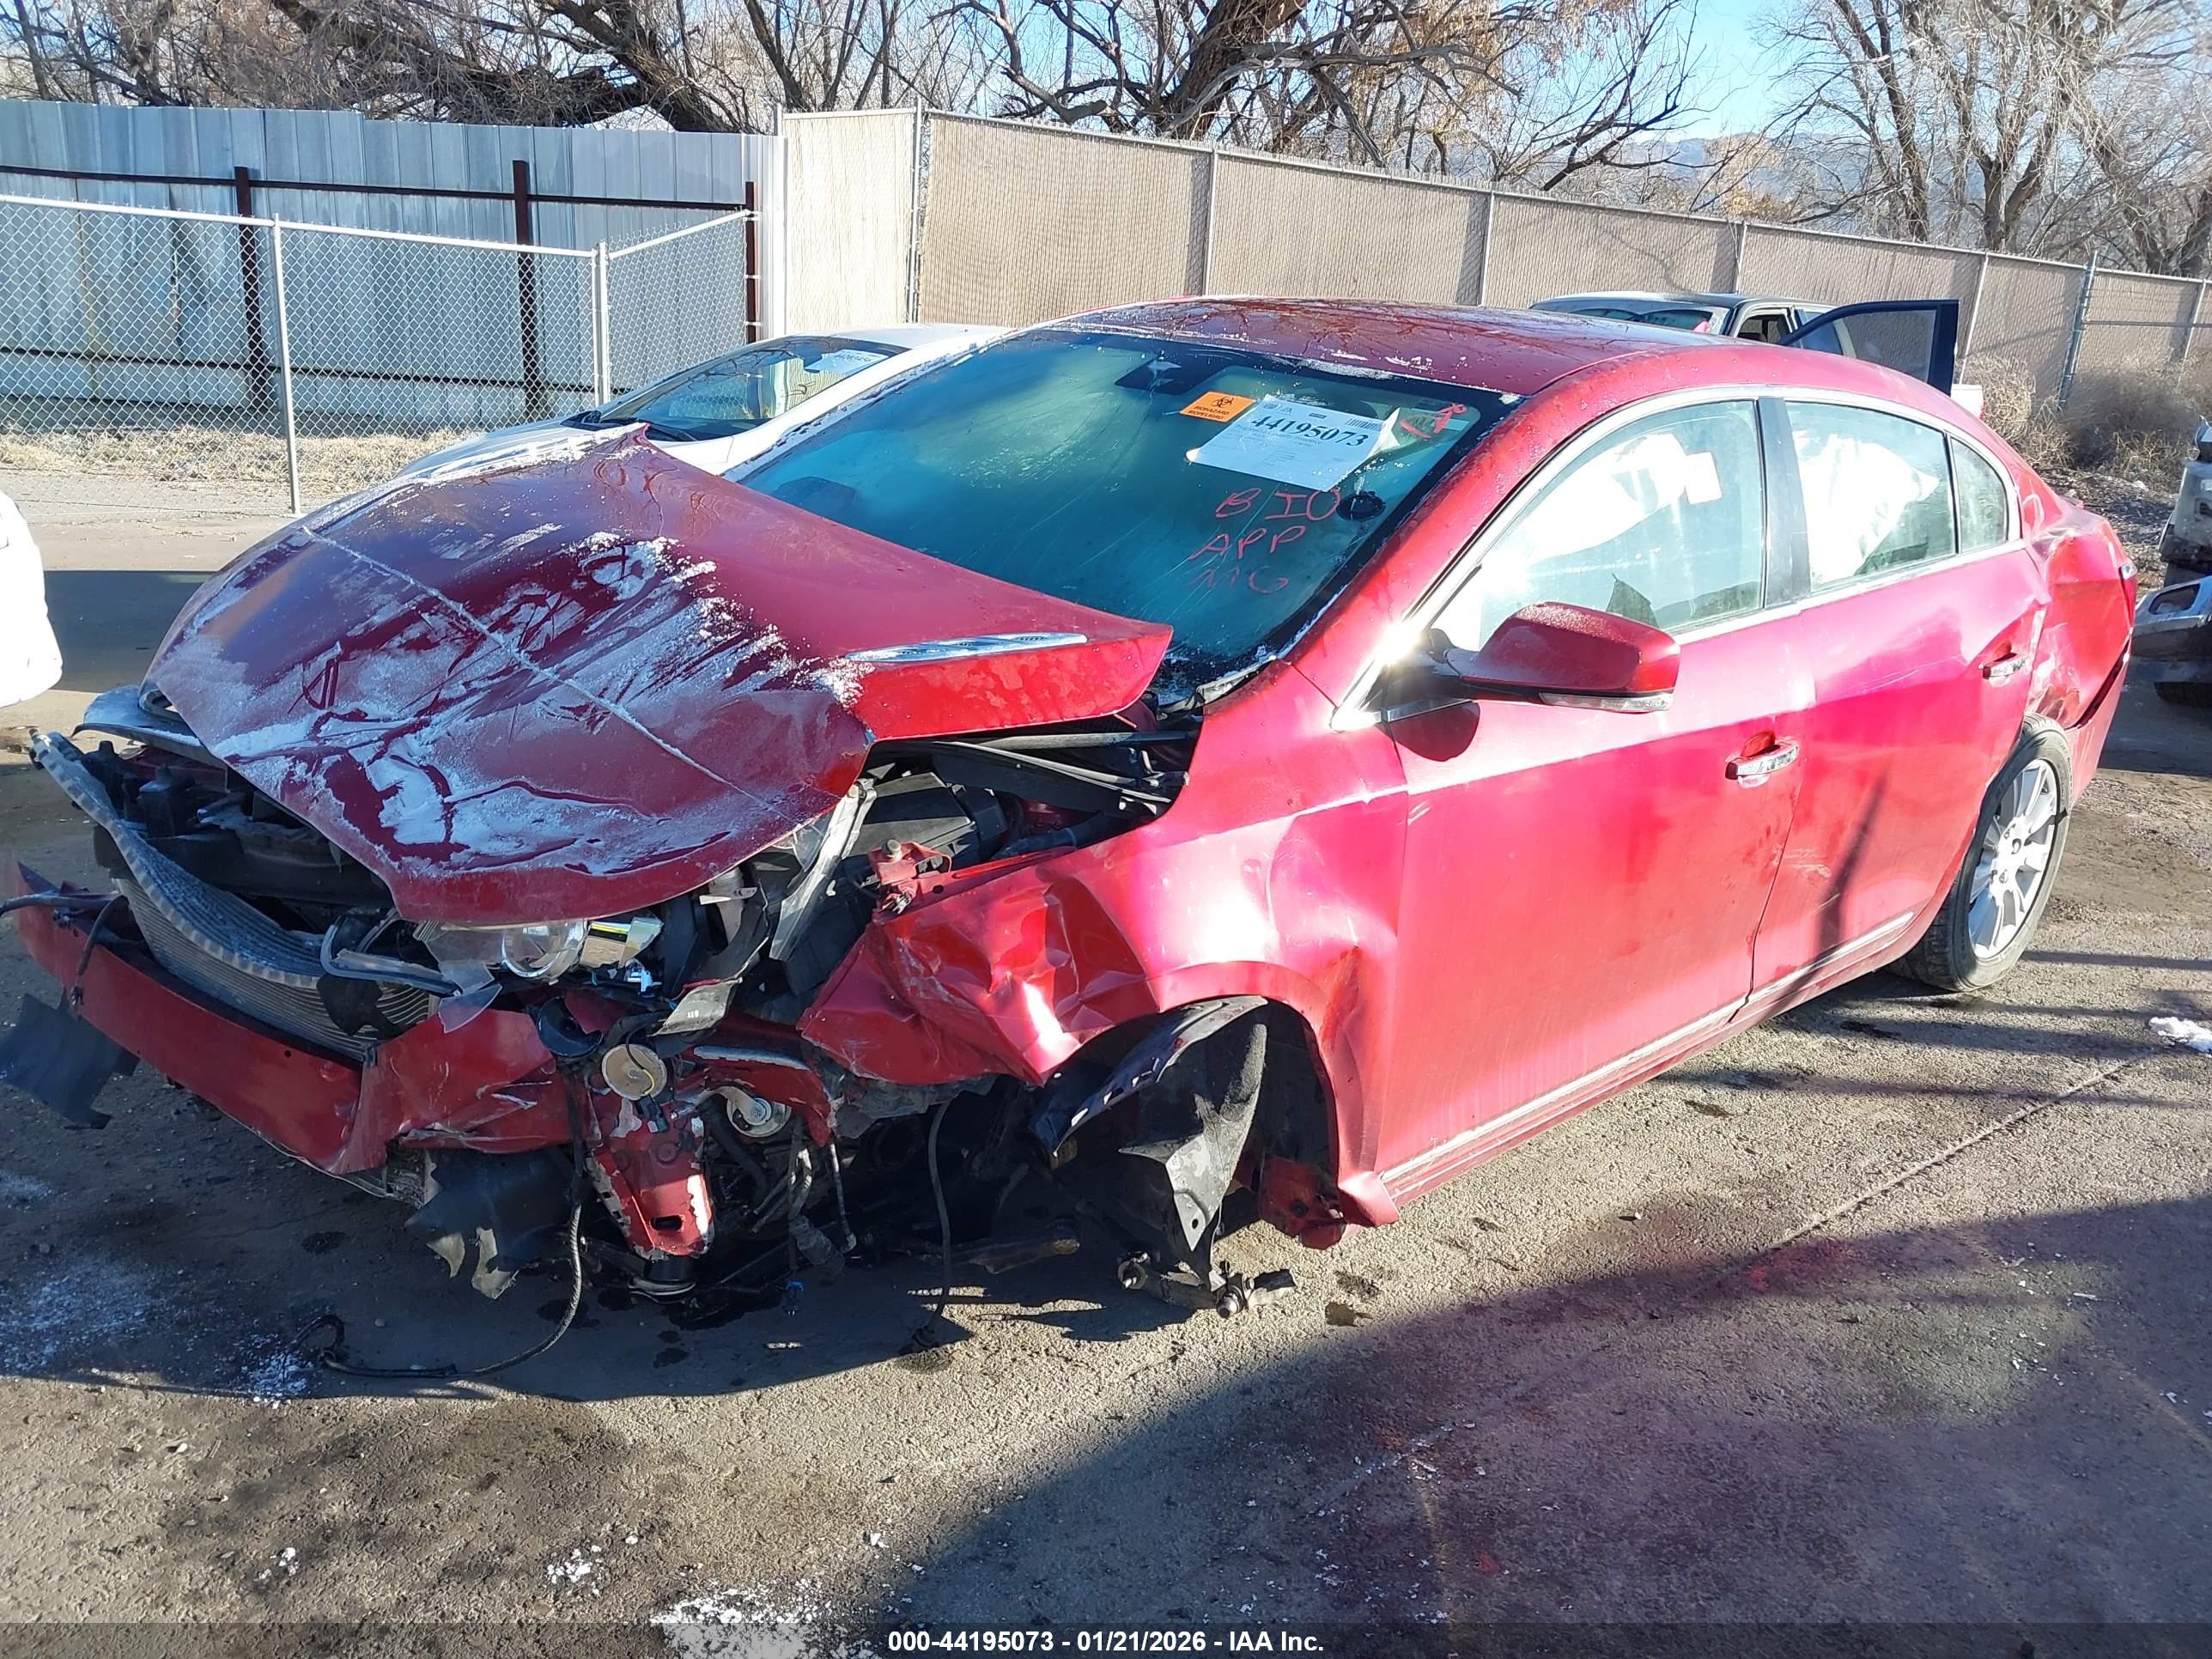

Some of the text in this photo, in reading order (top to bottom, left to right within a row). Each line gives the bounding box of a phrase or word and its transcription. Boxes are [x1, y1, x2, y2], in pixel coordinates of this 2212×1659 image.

[1251, 416, 1370, 447] 44195073
[1215, 487, 1341, 521] BIO
[1188, 525, 1306, 560] APP
